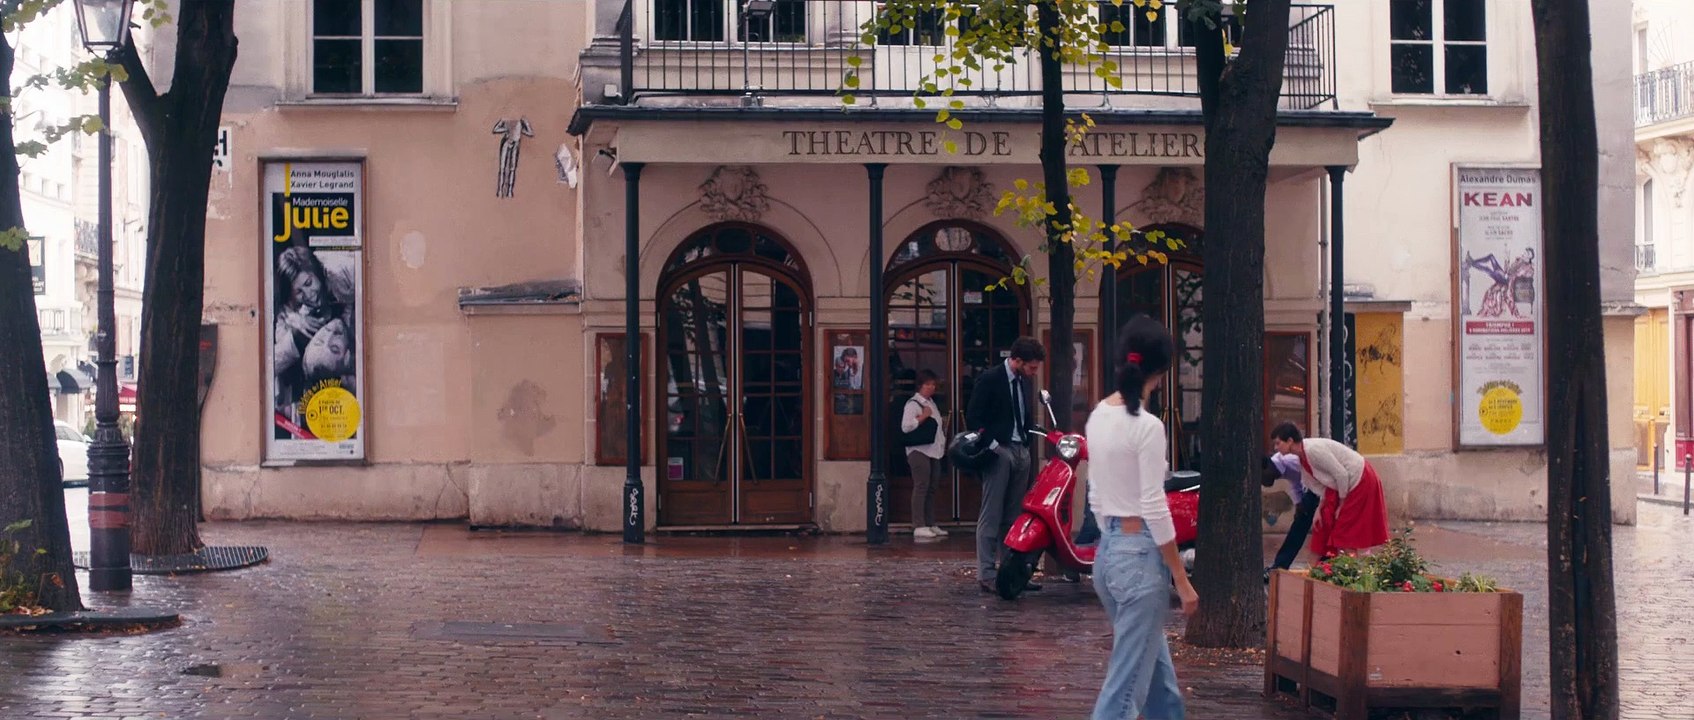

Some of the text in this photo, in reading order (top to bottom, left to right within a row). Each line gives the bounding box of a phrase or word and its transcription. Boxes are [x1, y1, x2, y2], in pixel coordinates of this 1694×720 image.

[782, 131, 1203, 157] THEATRE DE ATELIER
[314, 170, 354, 179] Mouglalis
[1461, 174, 1536, 184] Alexandre Dumas
[320, 181, 354, 190] Legrand
[293, 197, 347, 206] Mademoiselle
[1464, 192, 1532, 207] KEAN
